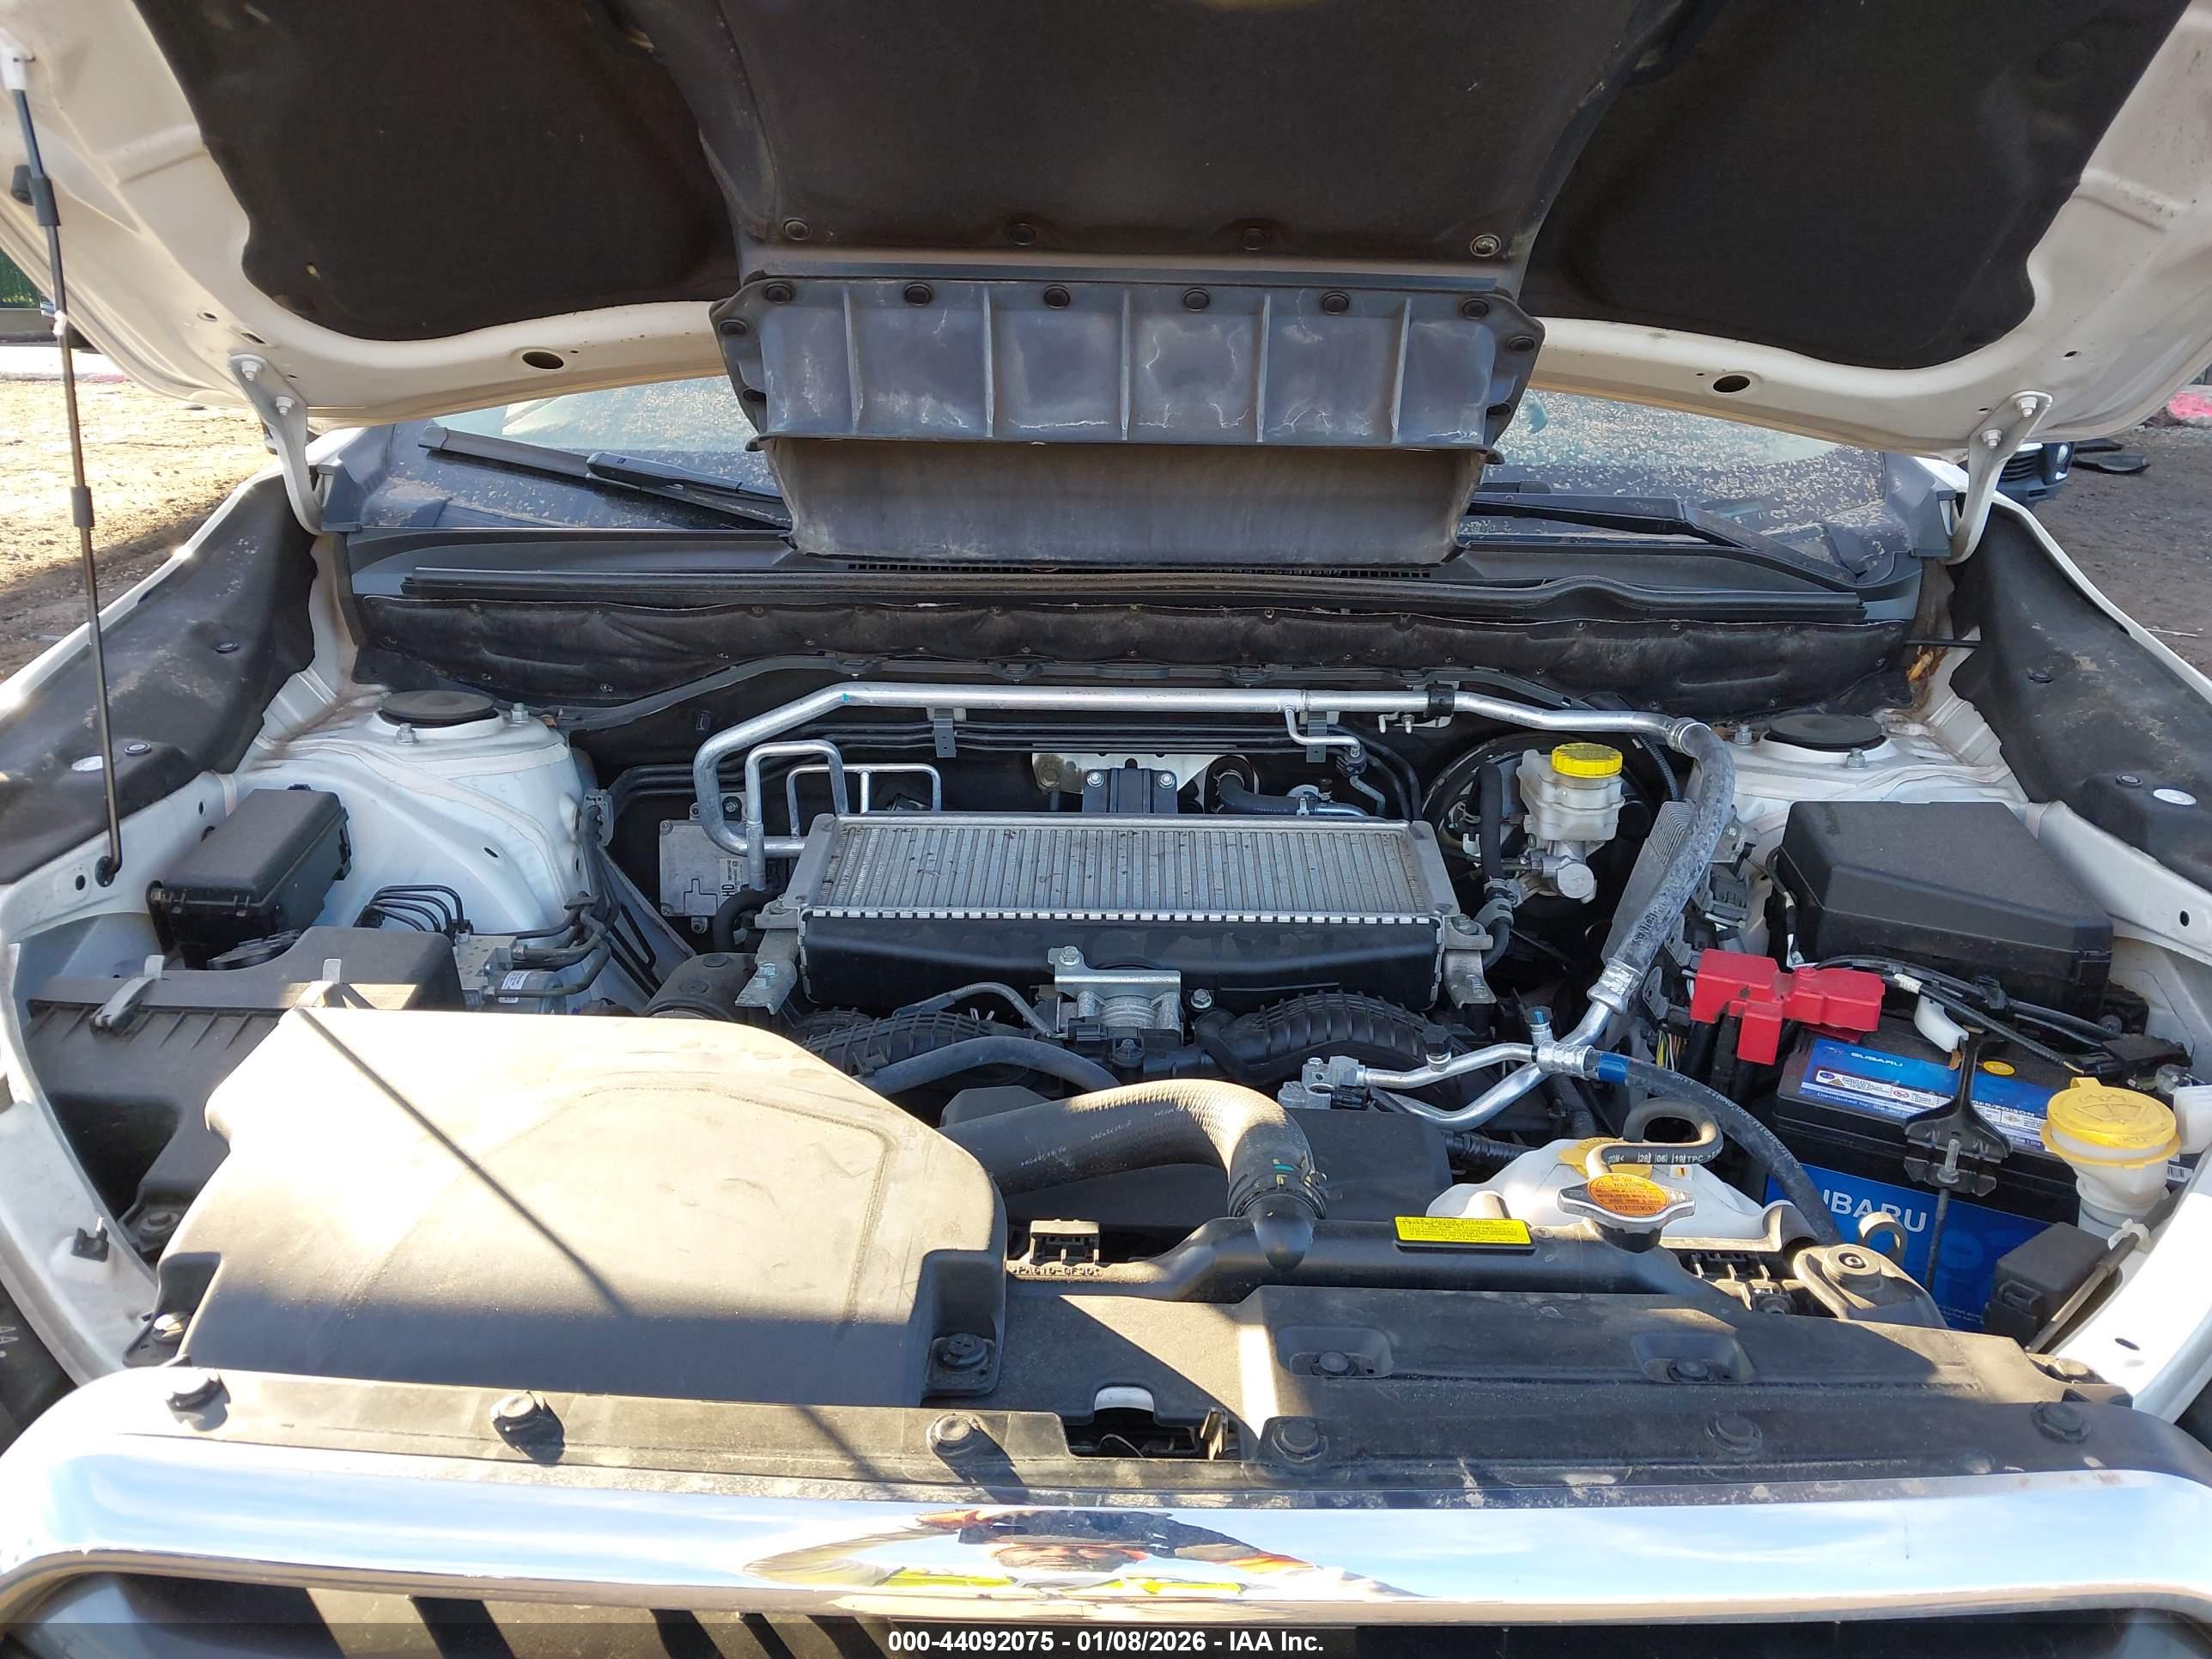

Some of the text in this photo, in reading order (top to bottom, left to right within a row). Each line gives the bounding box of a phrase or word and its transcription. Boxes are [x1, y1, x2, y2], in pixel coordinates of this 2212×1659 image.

[1850, 1051, 1904, 1067] SUBARU
[1971, 1099, 2035, 1117] GER/POISON
[1686, 1155, 1704, 1164] TPC
[1822, 1188, 1928, 1233] BARU
